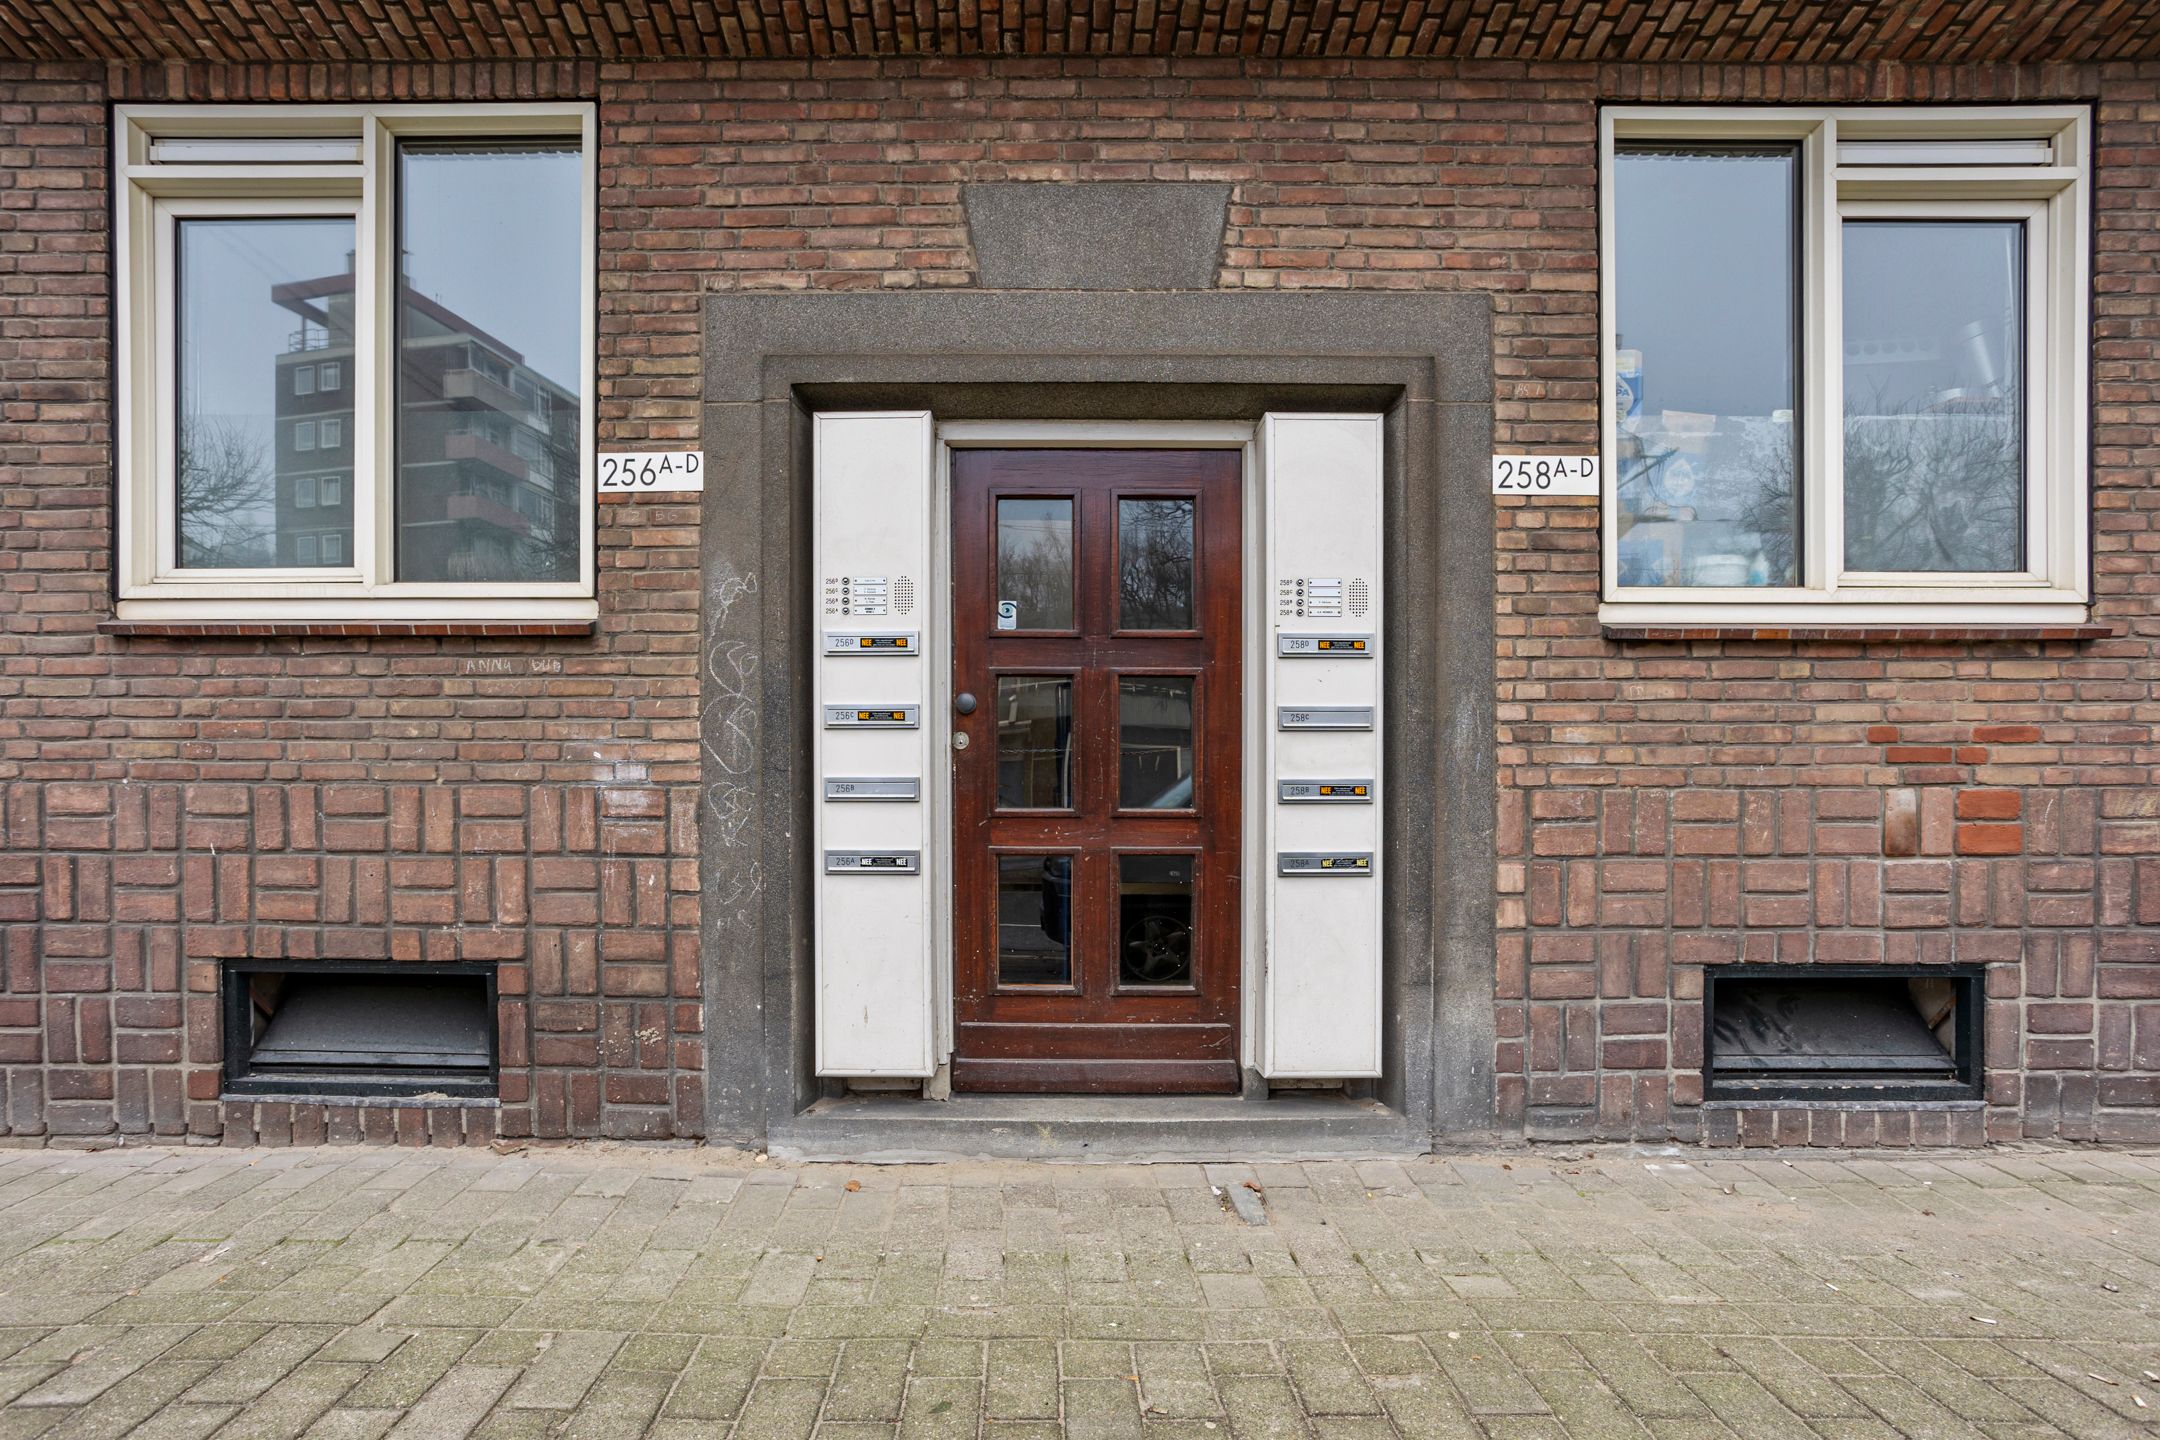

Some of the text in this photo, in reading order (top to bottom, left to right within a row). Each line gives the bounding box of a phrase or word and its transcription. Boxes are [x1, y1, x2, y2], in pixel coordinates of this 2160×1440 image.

[1319, 641, 1330, 649] NEE
[1353, 641, 1365, 649] NEE
[858, 712, 869, 720] NEE
[893, 712, 904, 720] NEE
[1320, 786, 1332, 795] NEE
[1354, 786, 1366, 795] NEE
[861, 858, 872, 866] NEE
[896, 858, 907, 866] NEE
[1322, 859, 1333, 867] NEE
[1356, 859, 1368, 867] NEE
